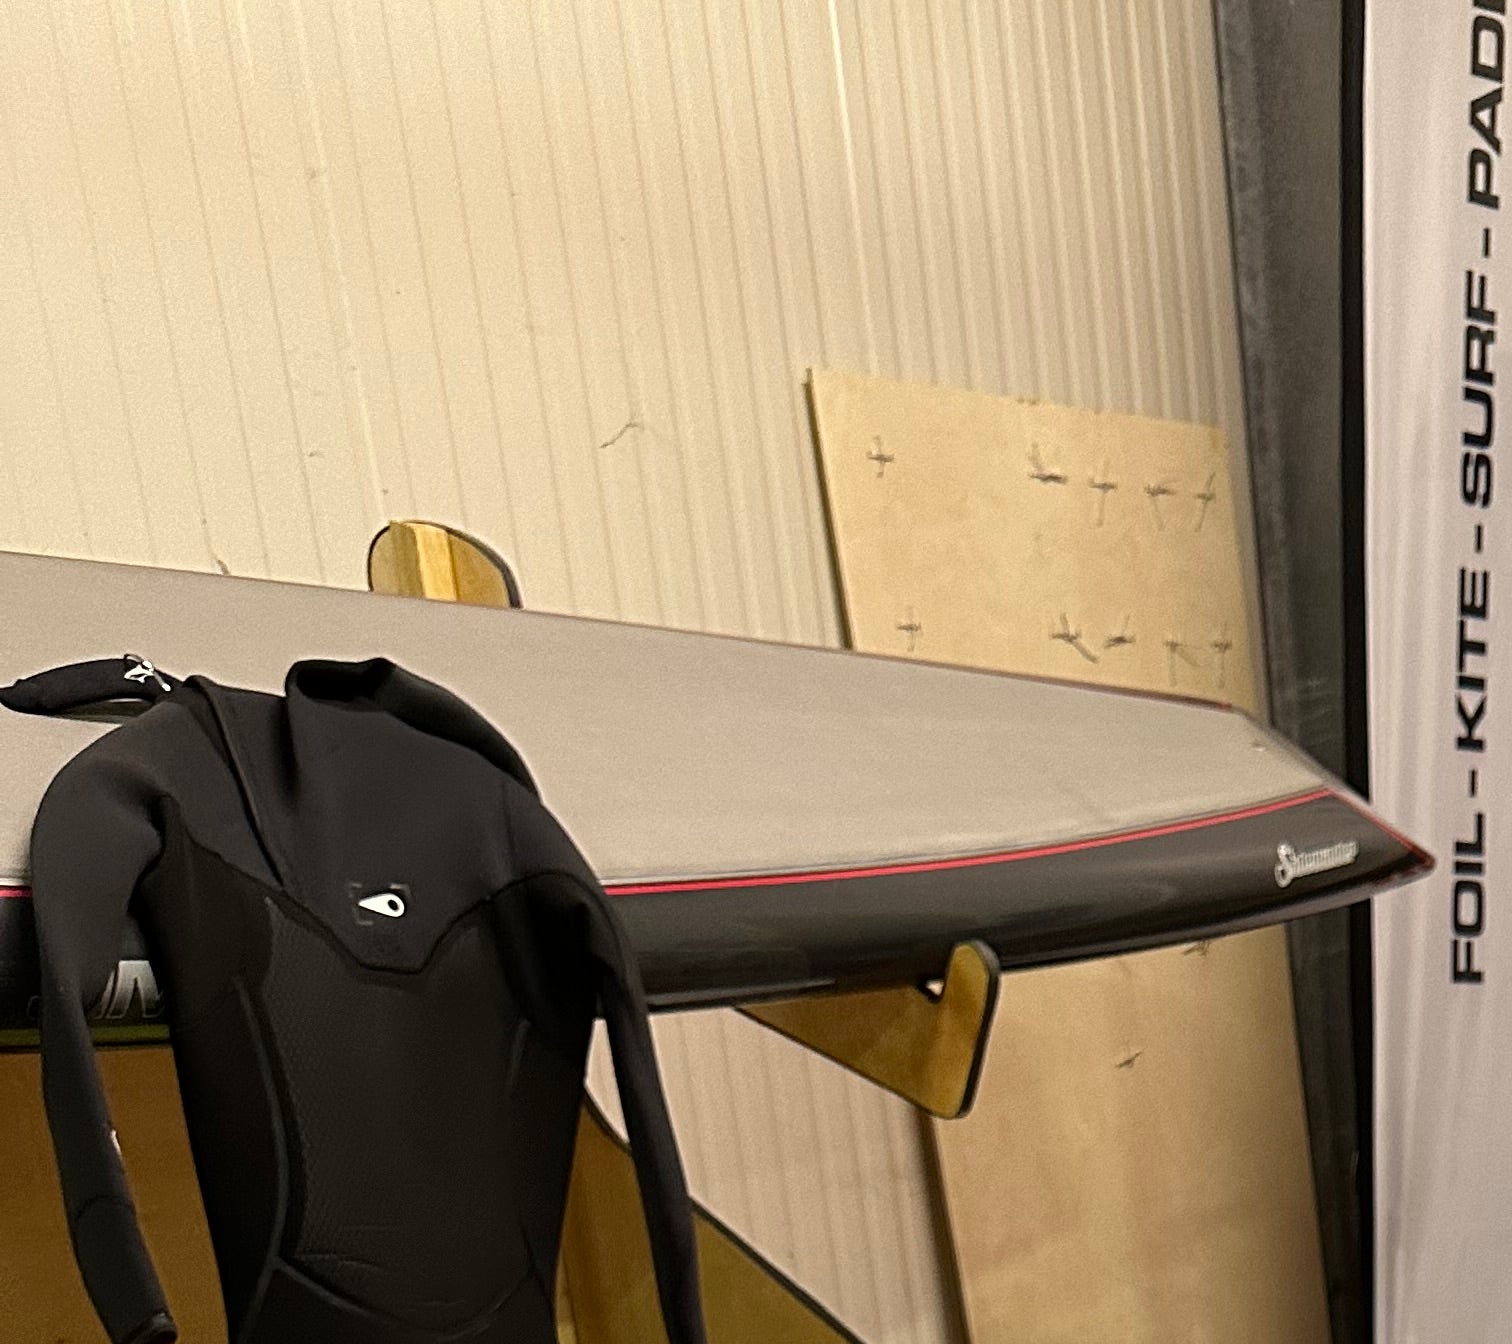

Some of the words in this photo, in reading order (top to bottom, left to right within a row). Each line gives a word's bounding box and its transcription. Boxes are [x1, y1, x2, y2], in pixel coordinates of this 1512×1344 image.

[1468, 0, 1507, 210] PAD
[1460, 269, 1498, 508] SURF
[1455, 567, 1489, 752] KITE
[1453, 812, 1487, 984] FOIL
